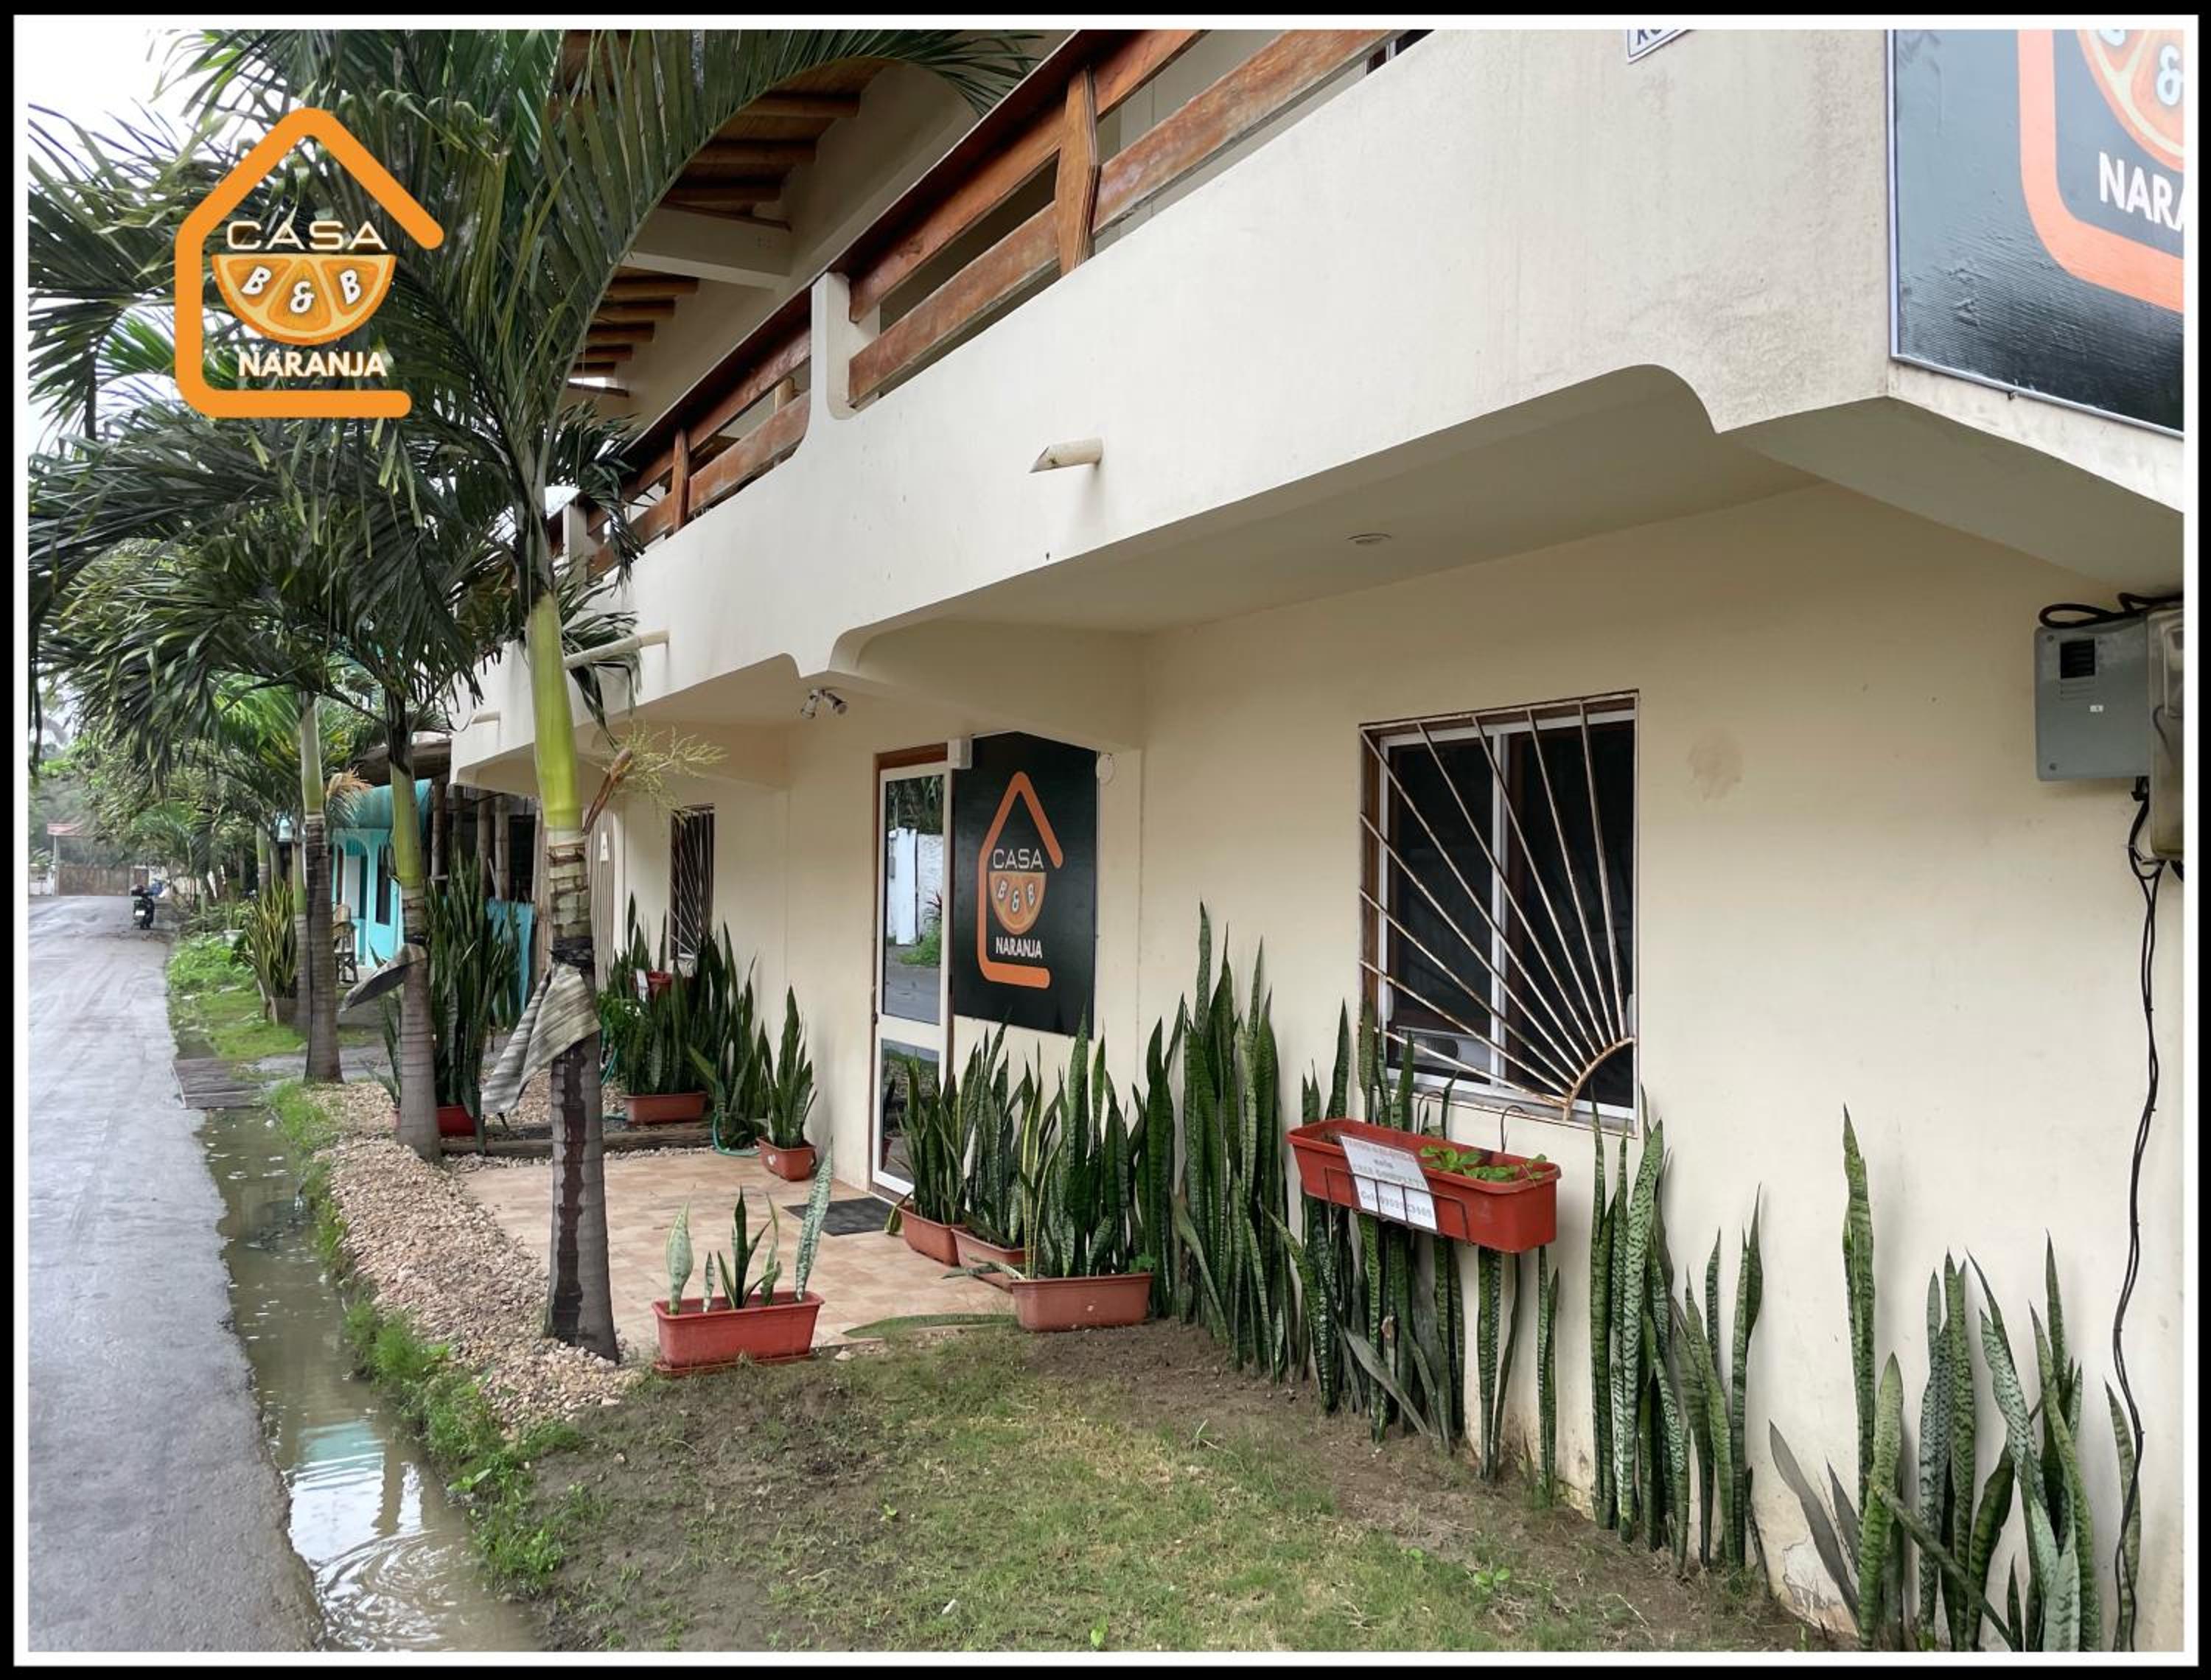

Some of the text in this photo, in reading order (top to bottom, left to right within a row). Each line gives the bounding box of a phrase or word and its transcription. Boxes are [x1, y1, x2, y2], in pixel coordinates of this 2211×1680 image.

[992, 848, 1044, 869] CASA
[997, 880, 1007, 900] B
[1011, 889, 1020, 913] &
[996, 937, 1043, 959] NARANJA
